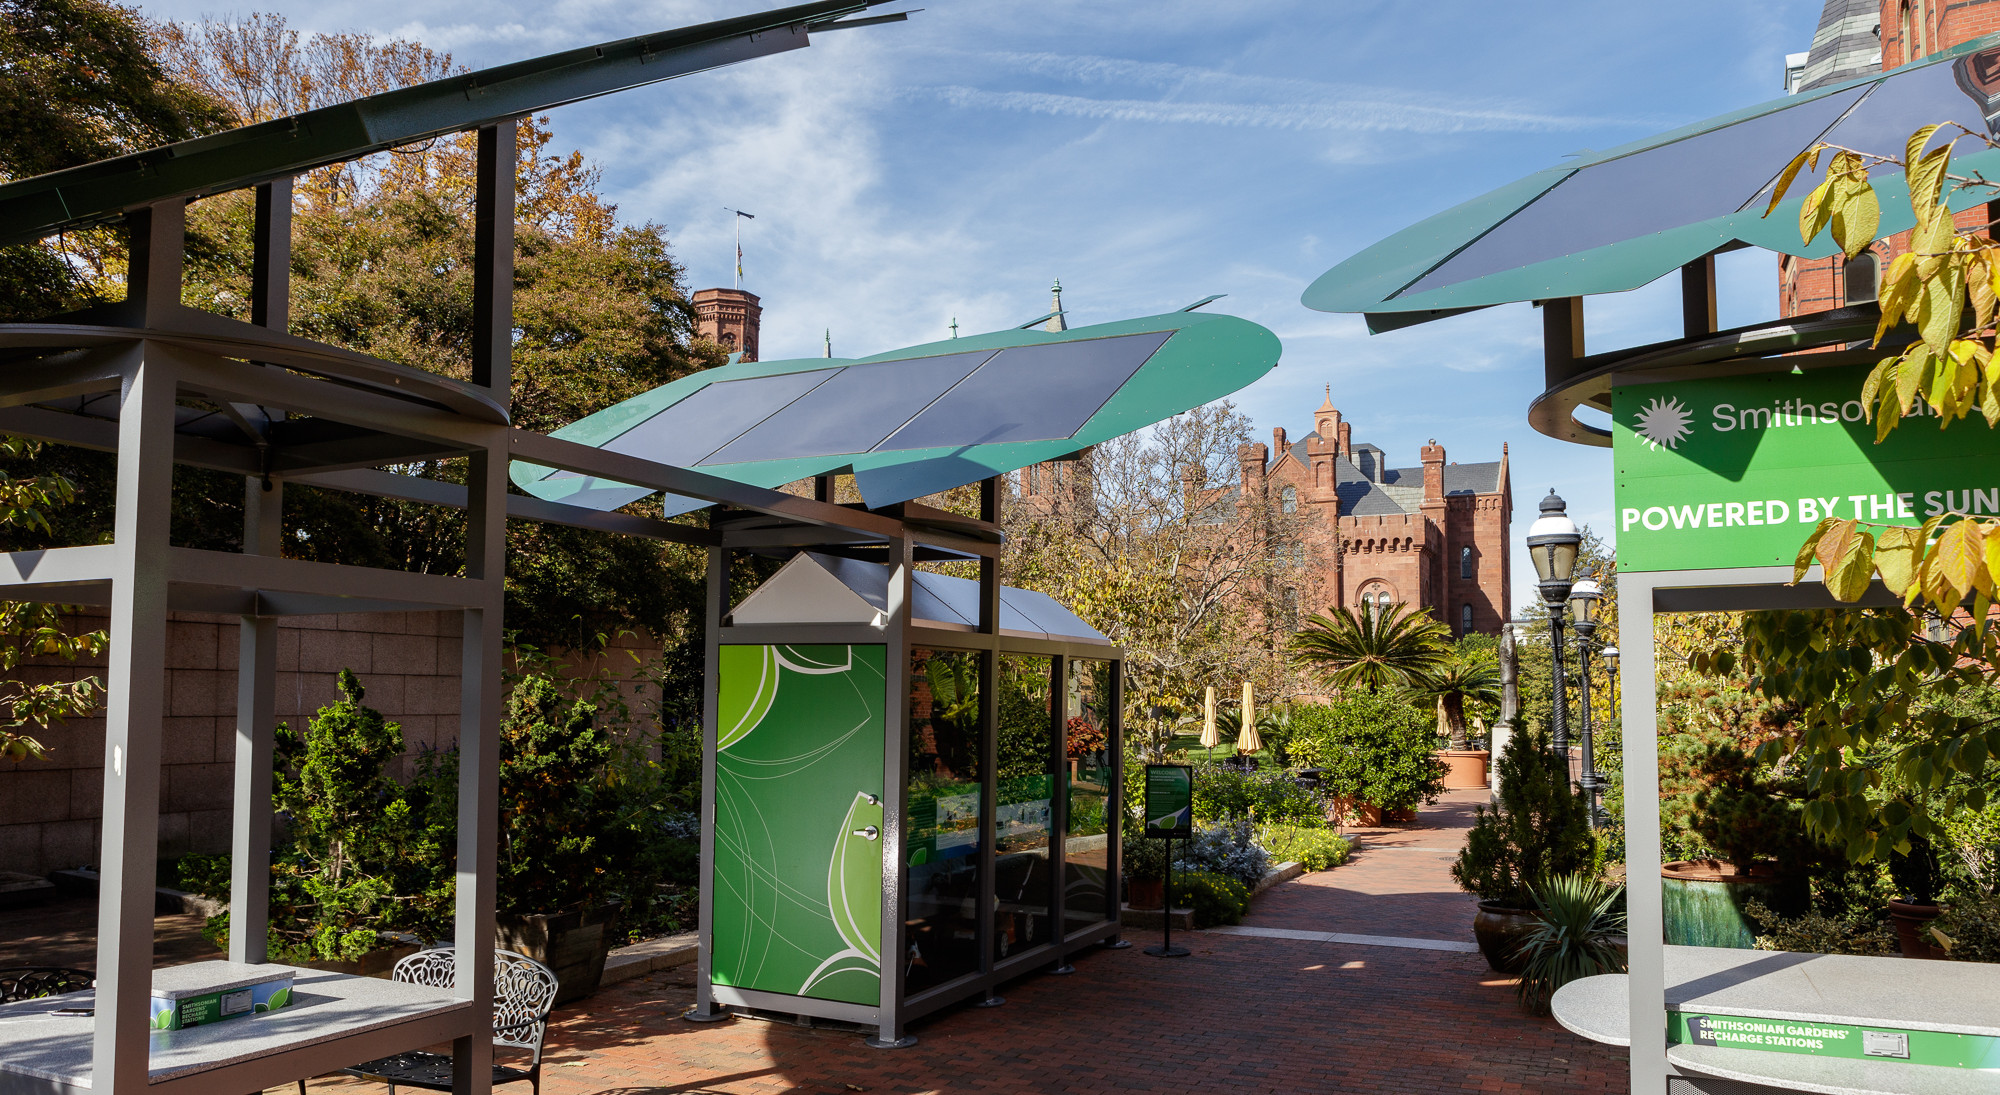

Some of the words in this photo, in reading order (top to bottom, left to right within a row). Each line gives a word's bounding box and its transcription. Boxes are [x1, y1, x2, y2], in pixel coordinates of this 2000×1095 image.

[1622, 501, 1790, 532] POWERED
[1798, 496, 1840, 523] BY
[1848, 492, 1915, 520] THE
[1924, 487, 1999, 517] SUN
[182, 998, 217, 1009] SMITHSONIAN
[181, 1010, 208, 1019] RECHARGE
[181, 1015, 205, 1024] STATIONS
[1700, 1019, 1785, 1033] SMITHSONIAN
[1700, 1030, 1763, 1044] RECHARGE
[1765, 1035, 1823, 1049] STATIONS
